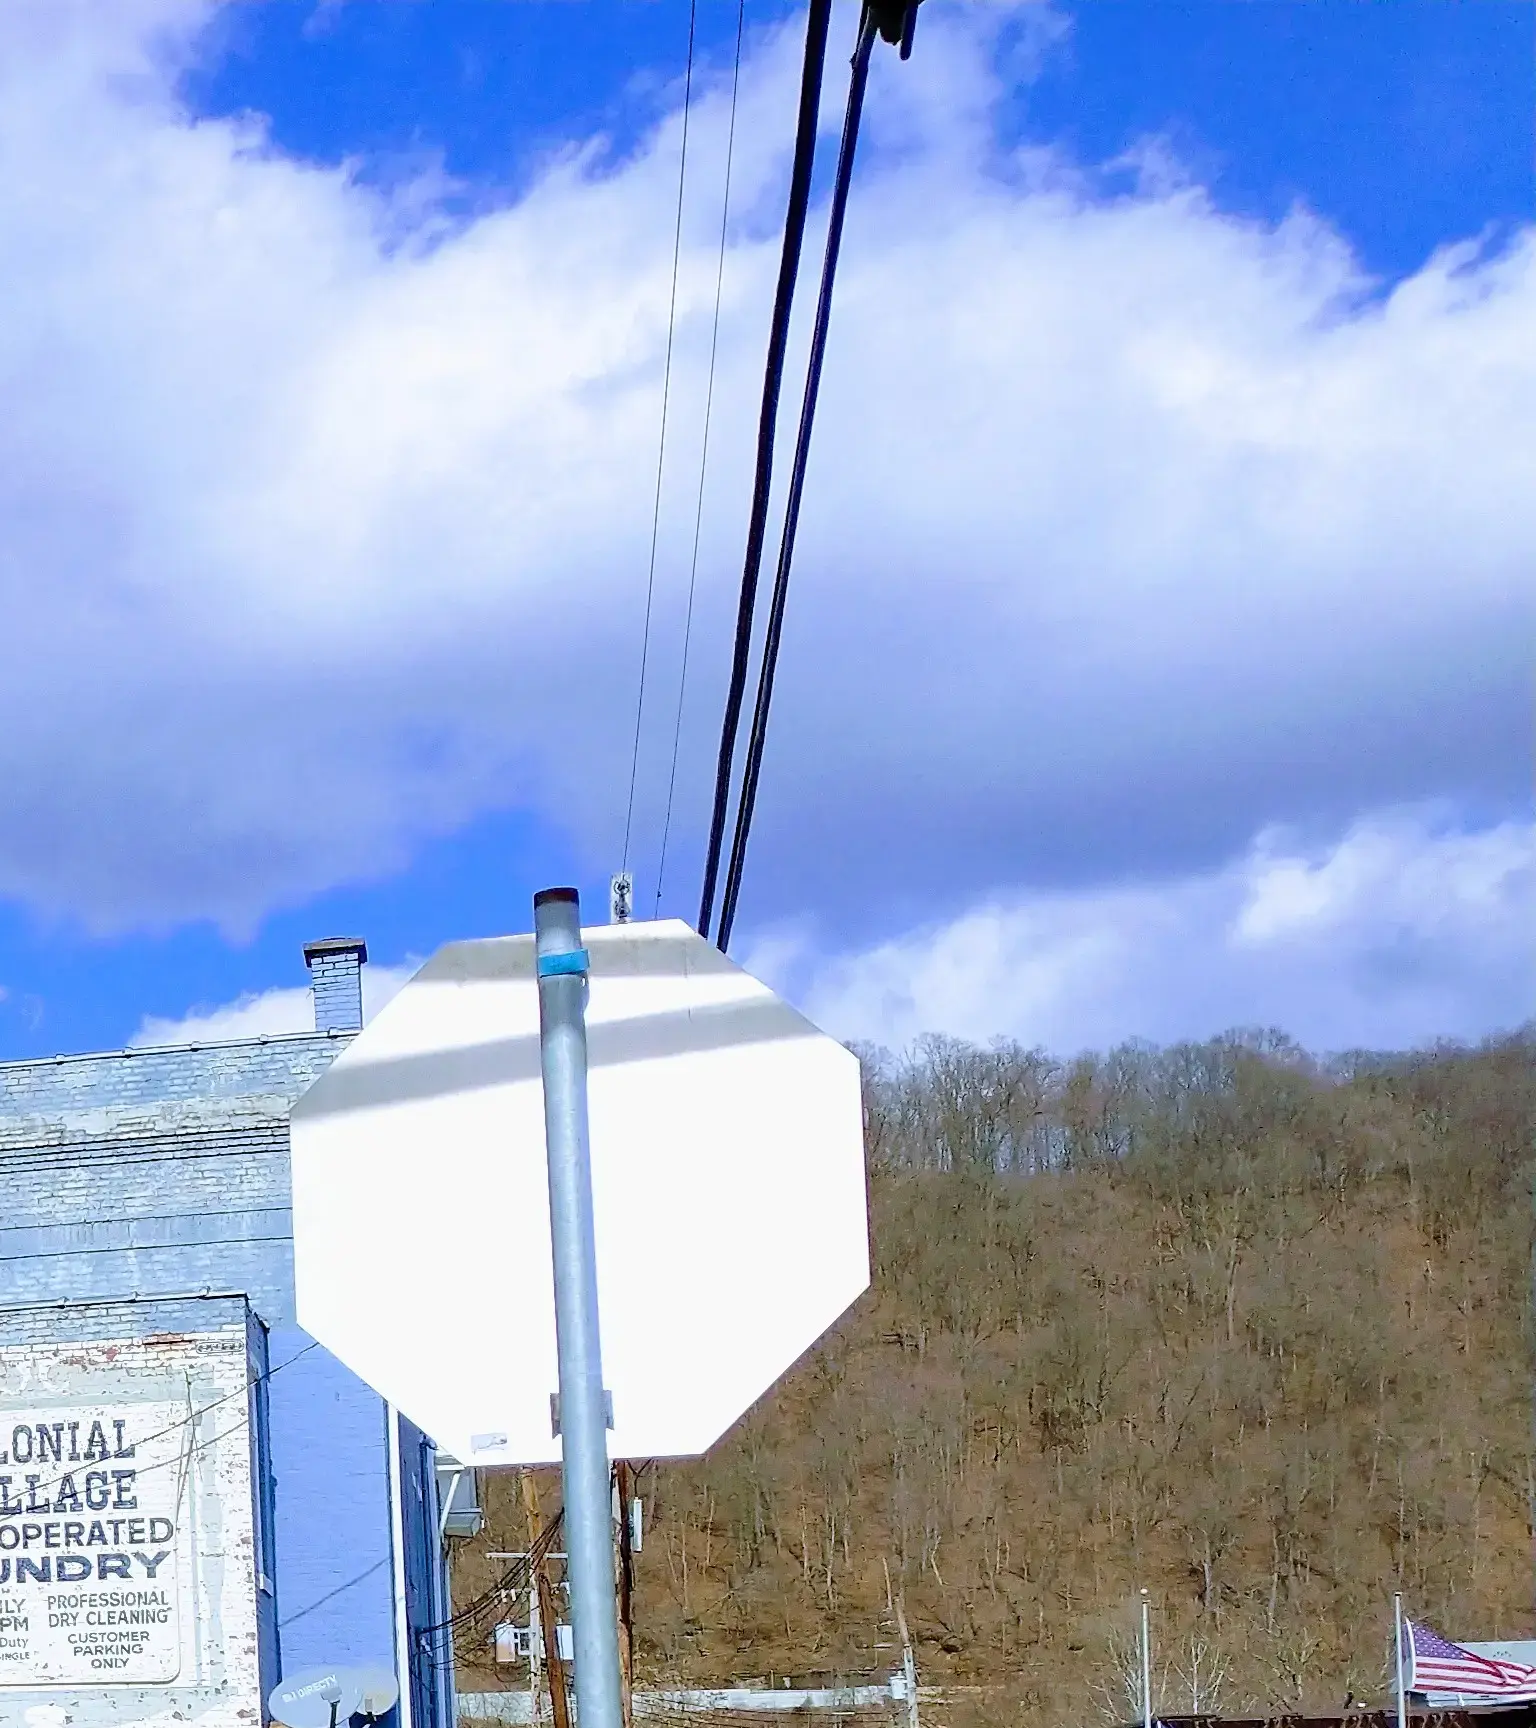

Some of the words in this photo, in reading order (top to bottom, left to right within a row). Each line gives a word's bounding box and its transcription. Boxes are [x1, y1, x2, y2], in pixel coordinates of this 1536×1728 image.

[47, 1590, 169, 1610] PROFESSIONAL
[48, 1612, 78, 1628] DRY
[86, 1607, 169, 1627] CLEANING
[0, 1636, 30, 1650] Duty
[67, 1630, 151, 1644] CUSTOMER
[73, 1643, 144, 1656] PARKING
[90, 1657, 130, 1670] ONLY
